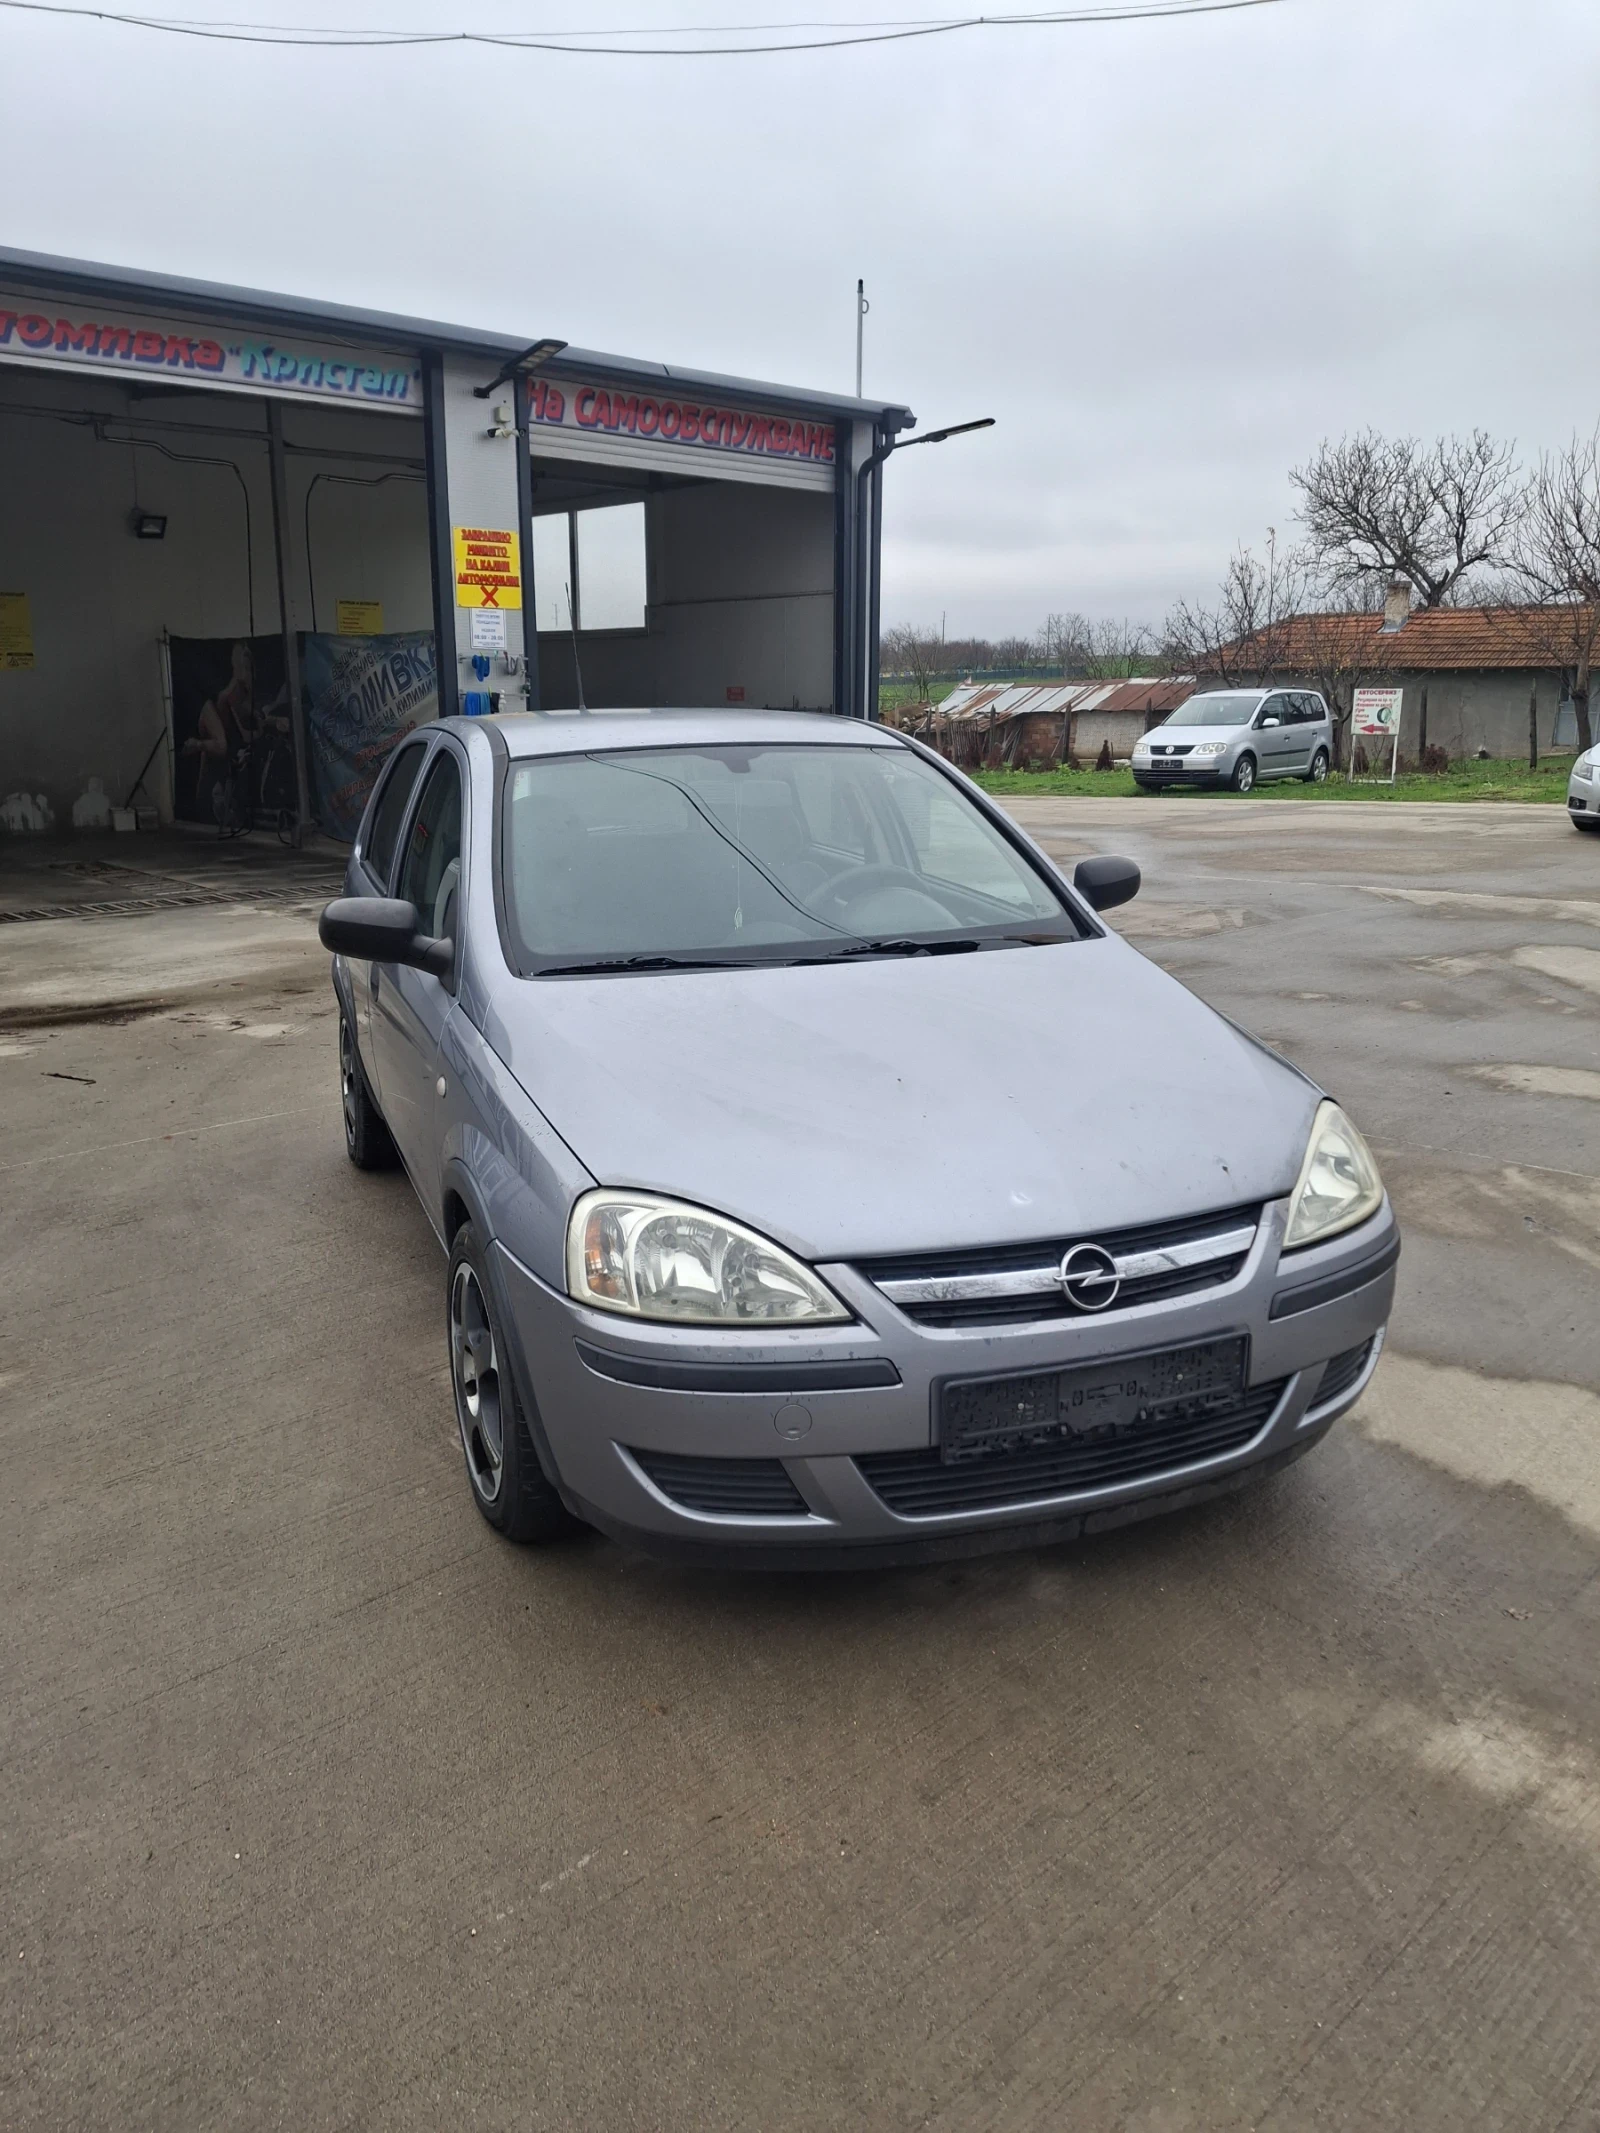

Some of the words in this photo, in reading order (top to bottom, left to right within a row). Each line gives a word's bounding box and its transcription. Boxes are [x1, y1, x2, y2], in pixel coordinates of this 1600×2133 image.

[527, 378, 566, 422] На
[574, 386, 836, 461] САМООБСЛУЖВАНЕ
[461, 529, 511, 543] ЗАБРАНЕНО
[395, 679, 433, 716] КИЛИМИ
